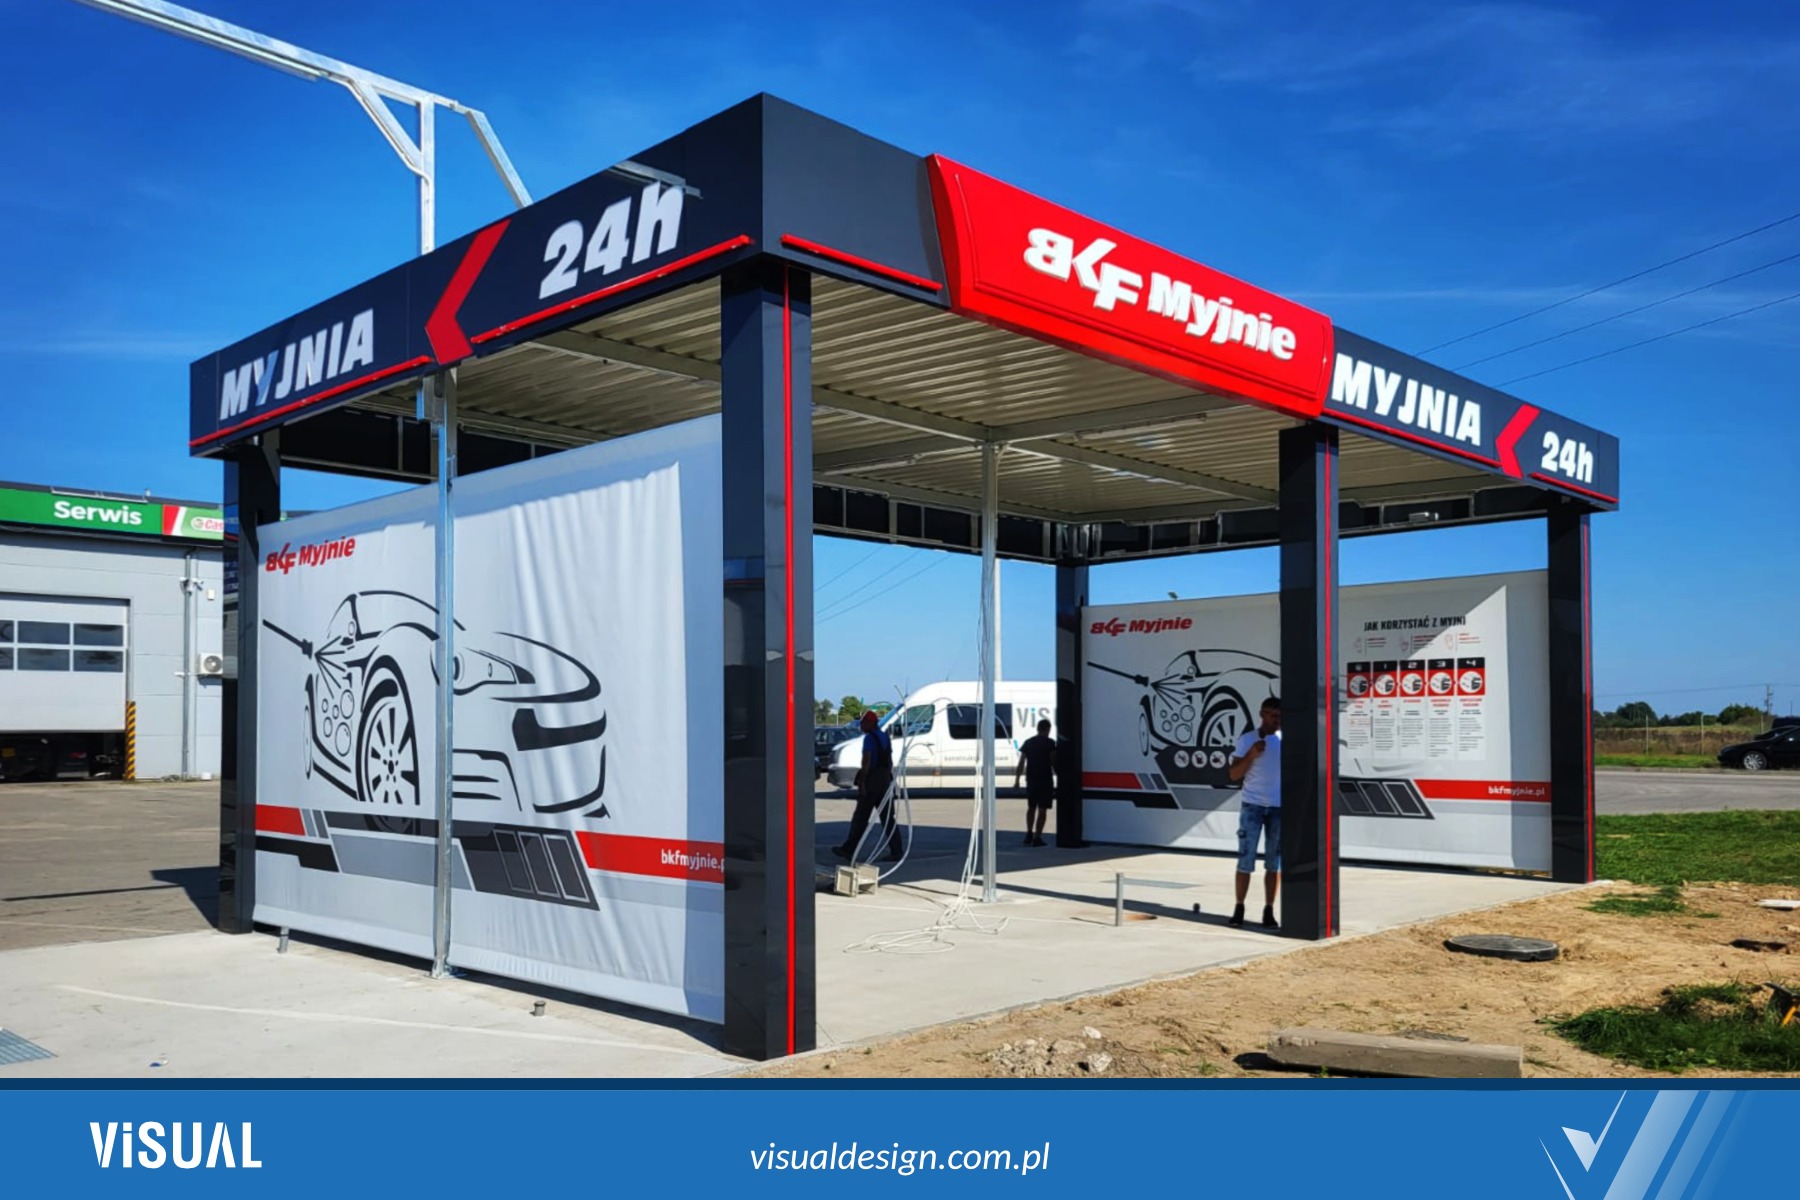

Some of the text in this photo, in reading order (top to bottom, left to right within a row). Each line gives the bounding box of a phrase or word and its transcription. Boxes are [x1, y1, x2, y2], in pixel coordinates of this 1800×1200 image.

[539, 180, 685, 300] 24h
[1023, 228, 1297, 360] BKF Myjnie
[220, 308, 374, 421] MYJNIA
[1331, 352, 1482, 447] MYJNIA
[1541, 431, 1594, 484] 24h
[53, 501, 142, 525] Serwis
[204, 518, 224, 532] Cas
[298, 535, 356, 567] Myjnie
[1128, 616, 1193, 634] Myjnie
[1363, 621, 1379, 631] JAK
[1381, 615, 1430, 630] KORZYSTAĆ
[1432, 618, 1439, 627] Z
[1016, 707, 1056, 728] ViS
[1488, 785, 1546, 797] bkfmyjnie.pl
[661, 848, 725, 873] bkfmyjnie.p
